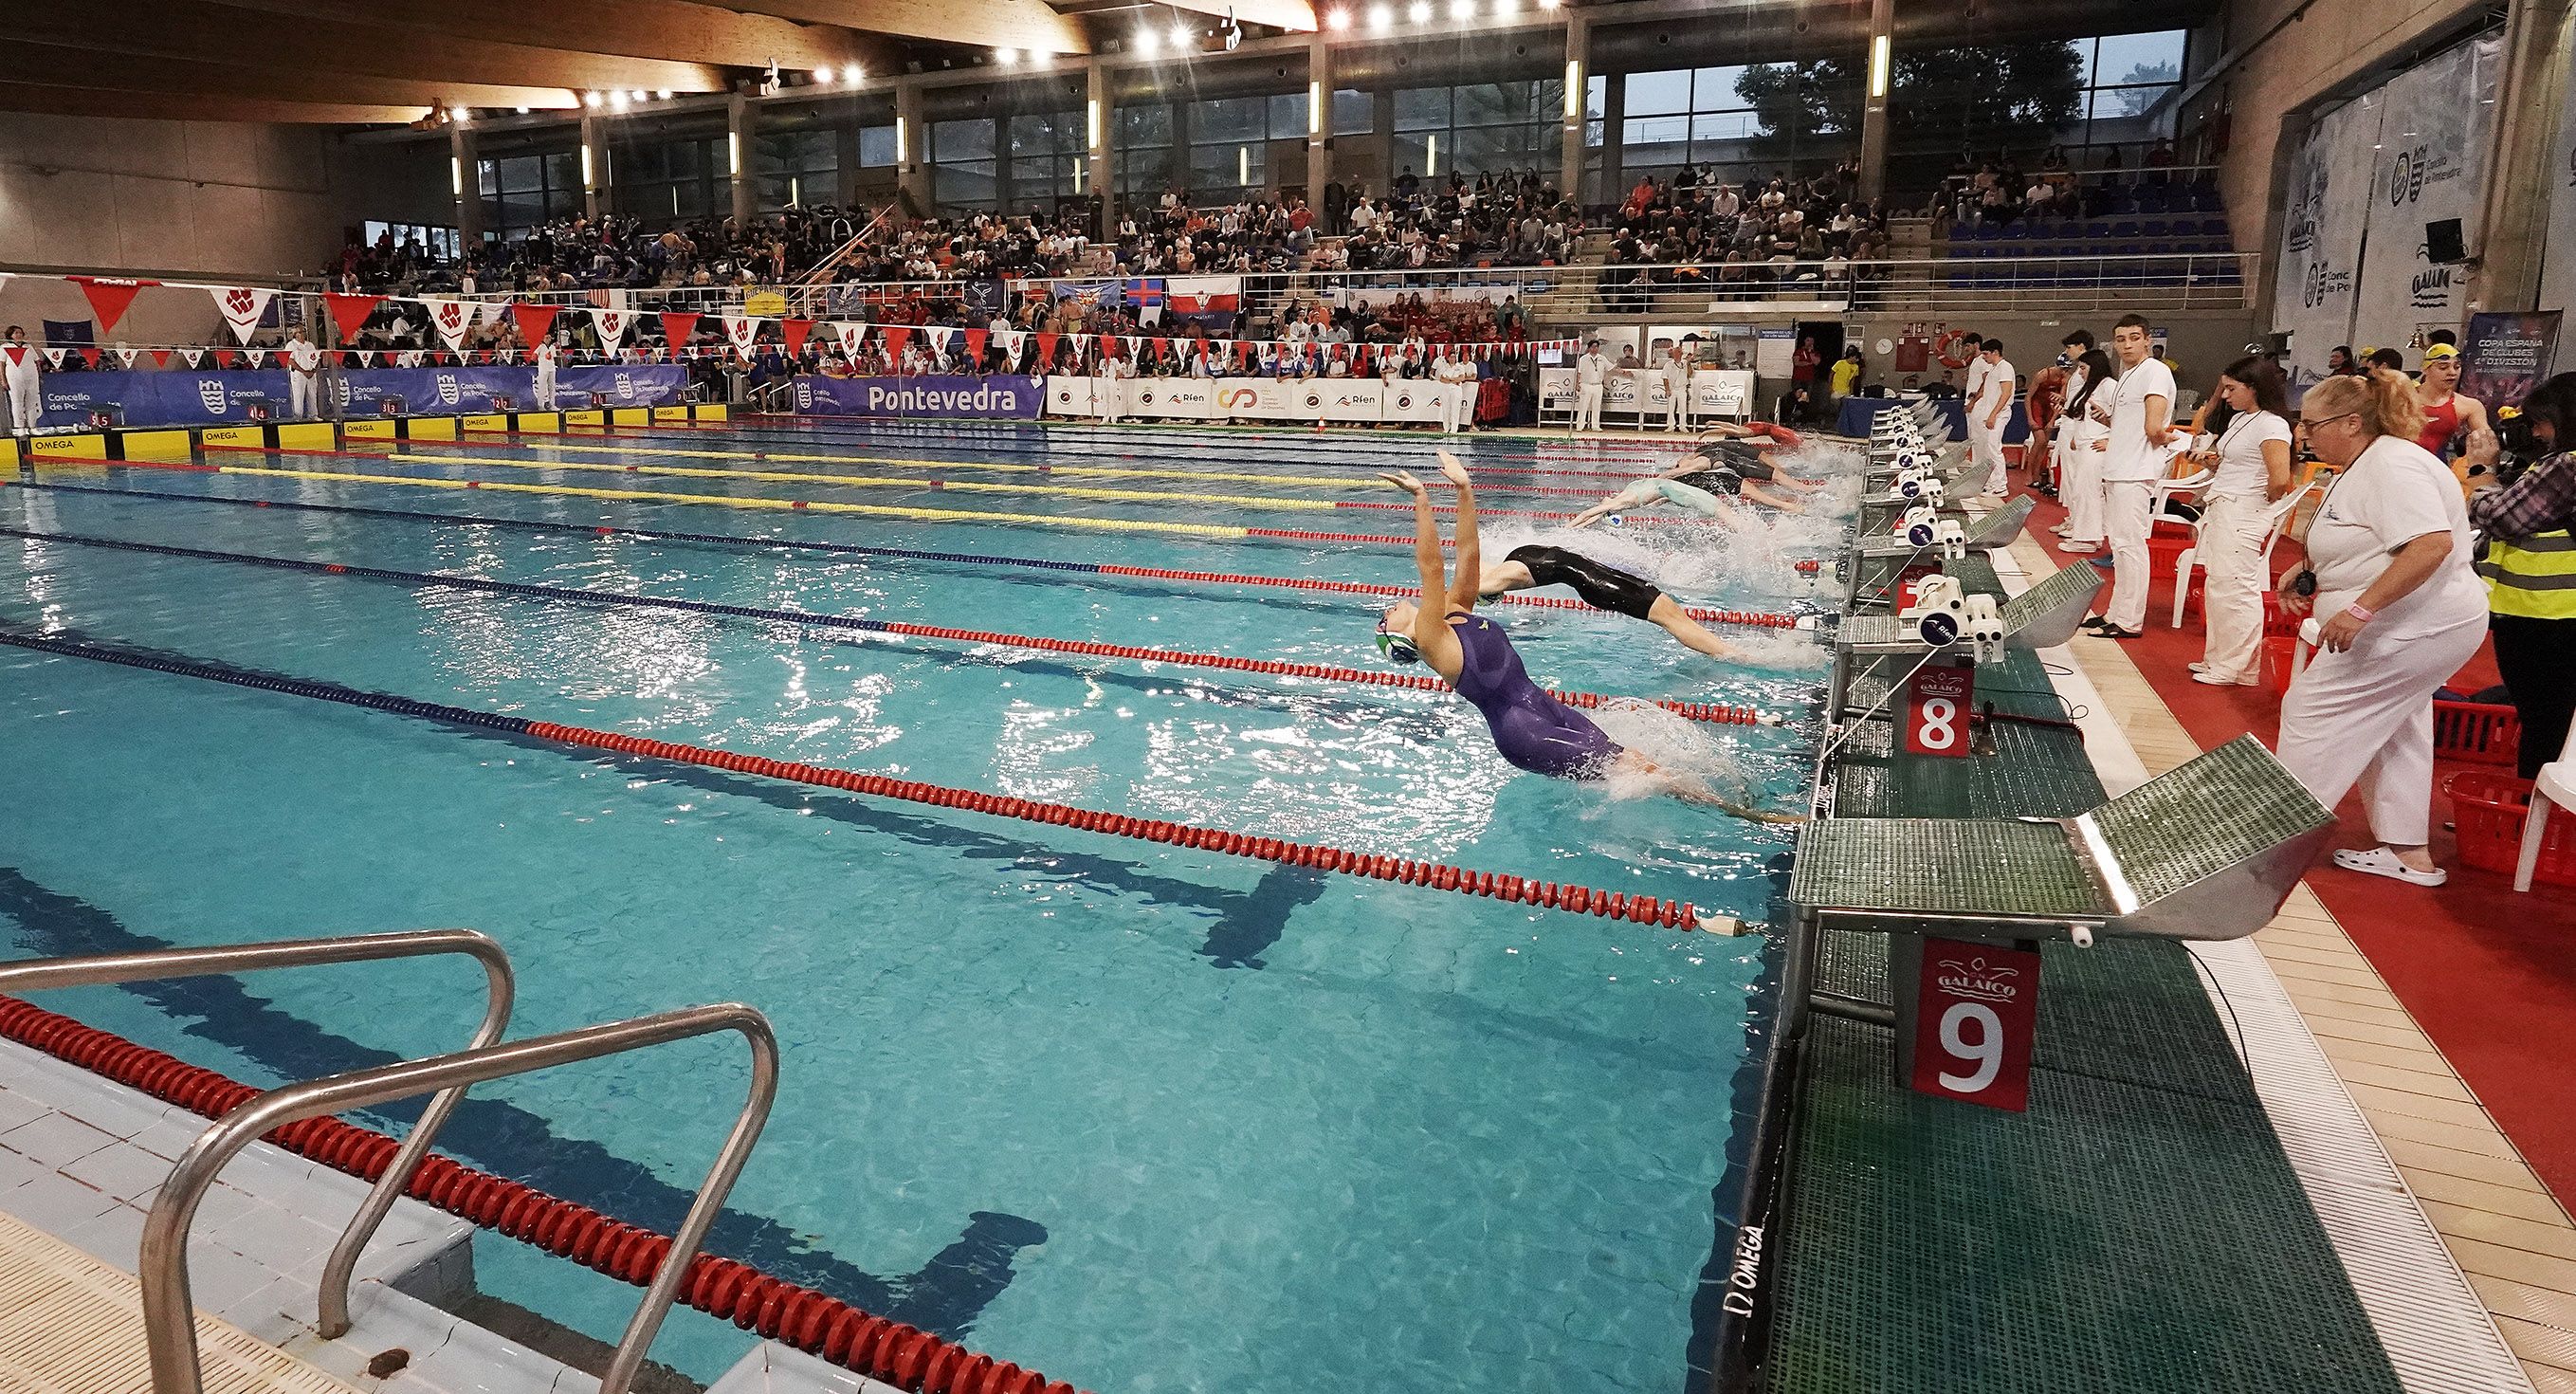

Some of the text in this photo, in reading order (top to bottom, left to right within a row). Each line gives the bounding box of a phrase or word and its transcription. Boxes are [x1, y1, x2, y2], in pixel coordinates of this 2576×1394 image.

[47, 393, 90, 402] Concello
[868, 383, 1016, 411] Pontevedra
[1183, 394, 1204, 402] Rfen
[1352, 395, 1376, 404] Rfen
[258, 410, 265, 419] 4
[101, 415, 108, 426] 5
[206, 431, 238, 441] OMEGA
[35, 441, 74, 449] OMEGA
[1920, 684, 1963, 694] GALAICO
[1918, 697, 1956, 749] 8
[1938, 975, 2017, 997] GALAICO
[1939, 1001, 2003, 1093] 9
[1729, 1225, 1764, 1290] OMEGA
